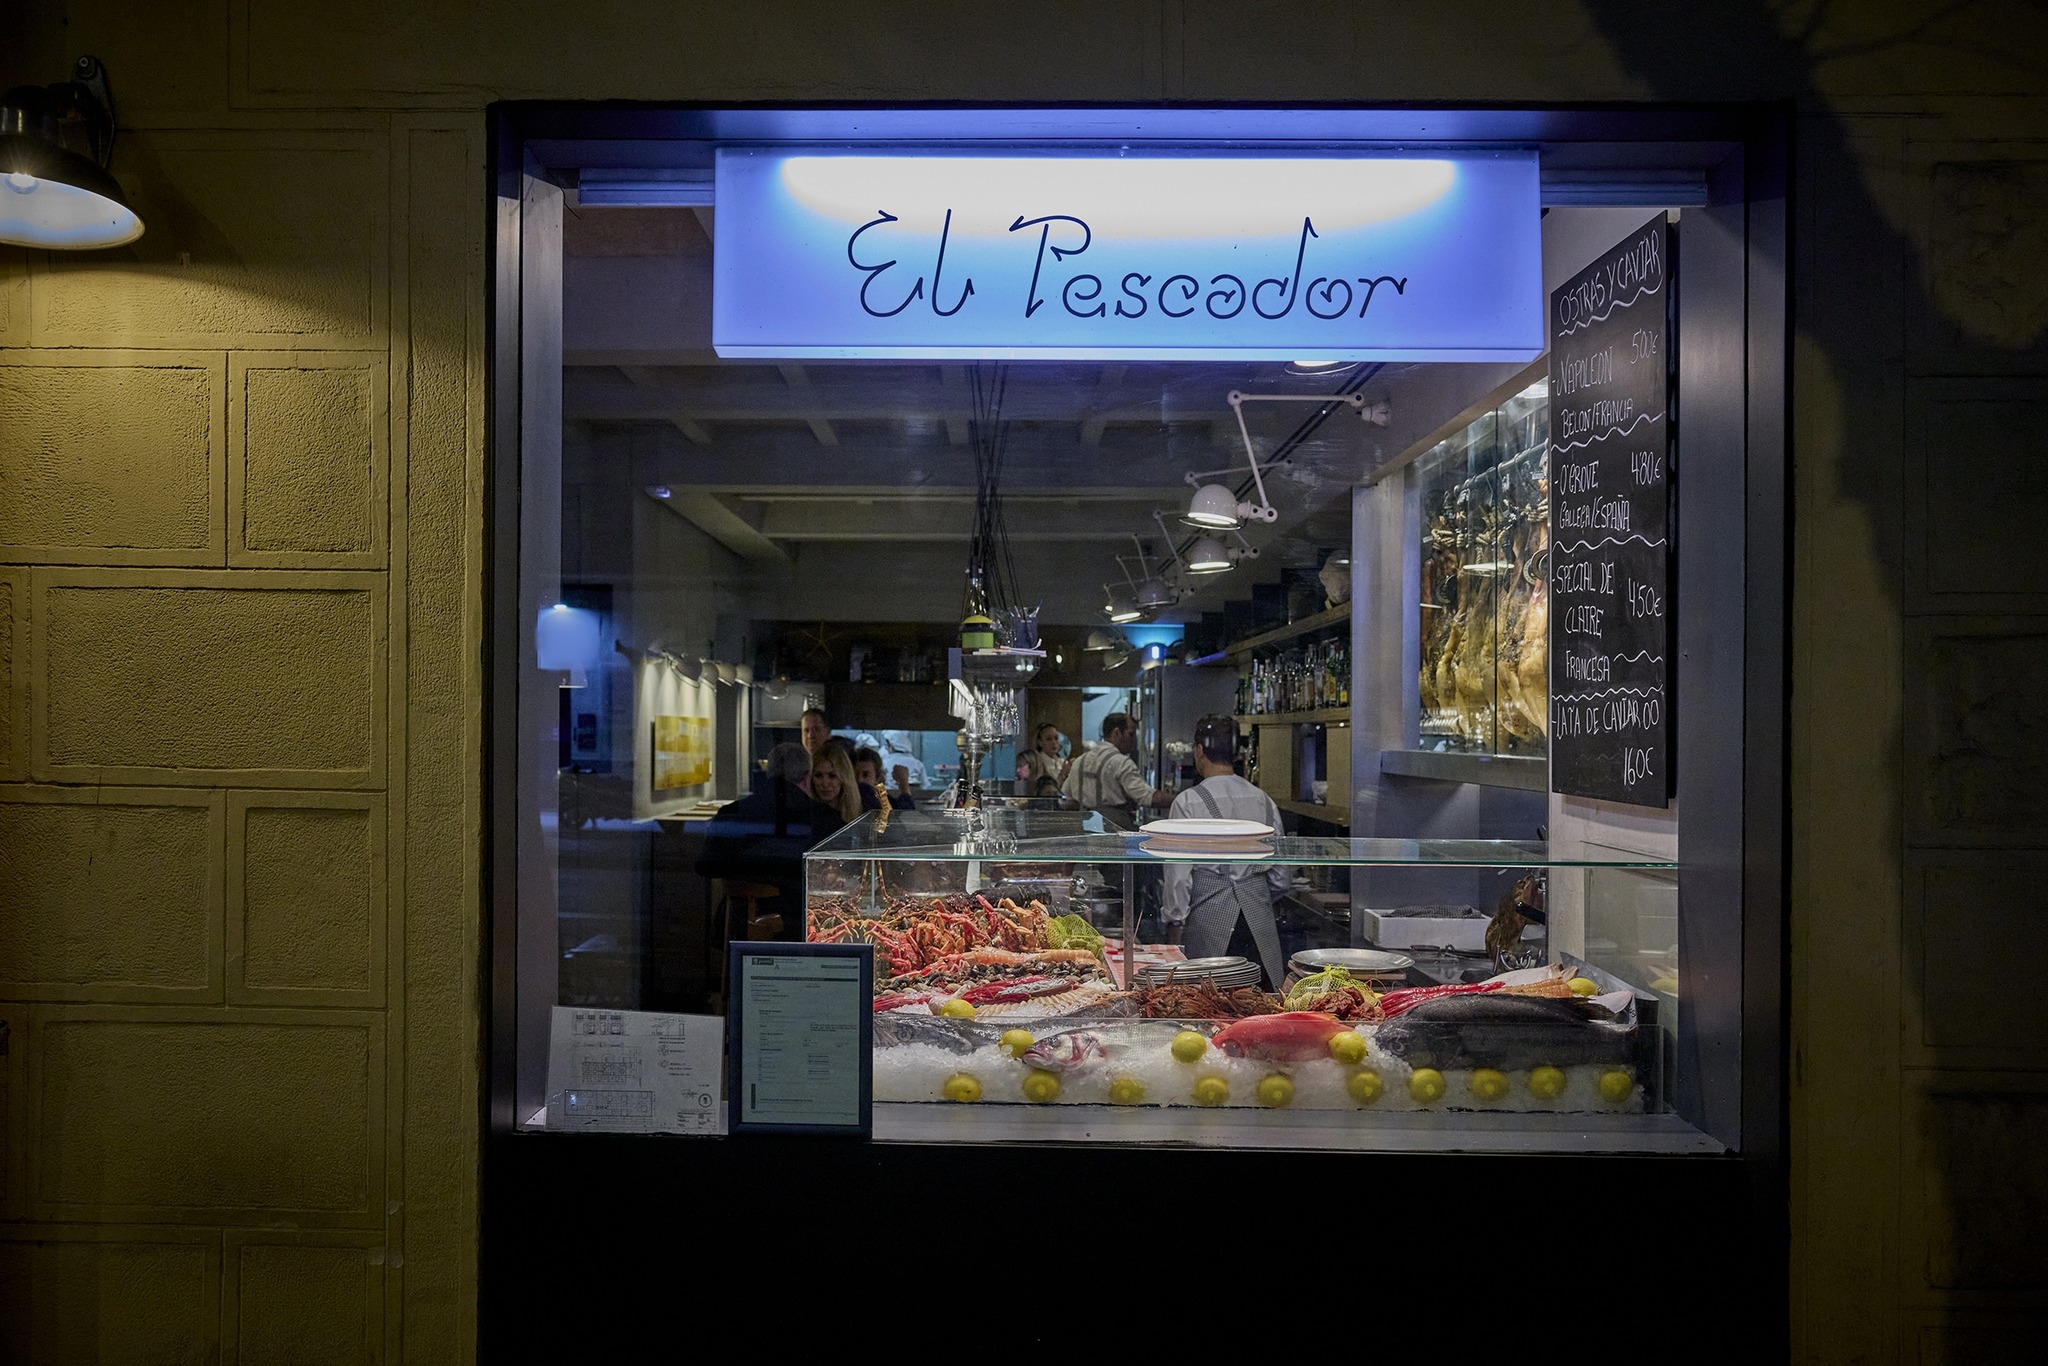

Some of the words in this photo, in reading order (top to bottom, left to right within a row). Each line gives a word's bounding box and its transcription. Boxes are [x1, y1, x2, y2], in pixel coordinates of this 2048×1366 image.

[848, 208, 976, 318] El
[1008, 214, 1409, 319] Pescador
[1559, 271, 1605, 325] OSTRAS
[1606, 263, 1616, 301] Y
[1617, 229, 1662, 290] CAVIAR
[1599, 562, 1615, 595] DE
[1564, 605, 1604, 639] CLAIRE
[1566, 650, 1610, 682] FRANCESA
[1585, 707, 1599, 735] DE
[1602, 697, 1641, 733] CAVIAR
